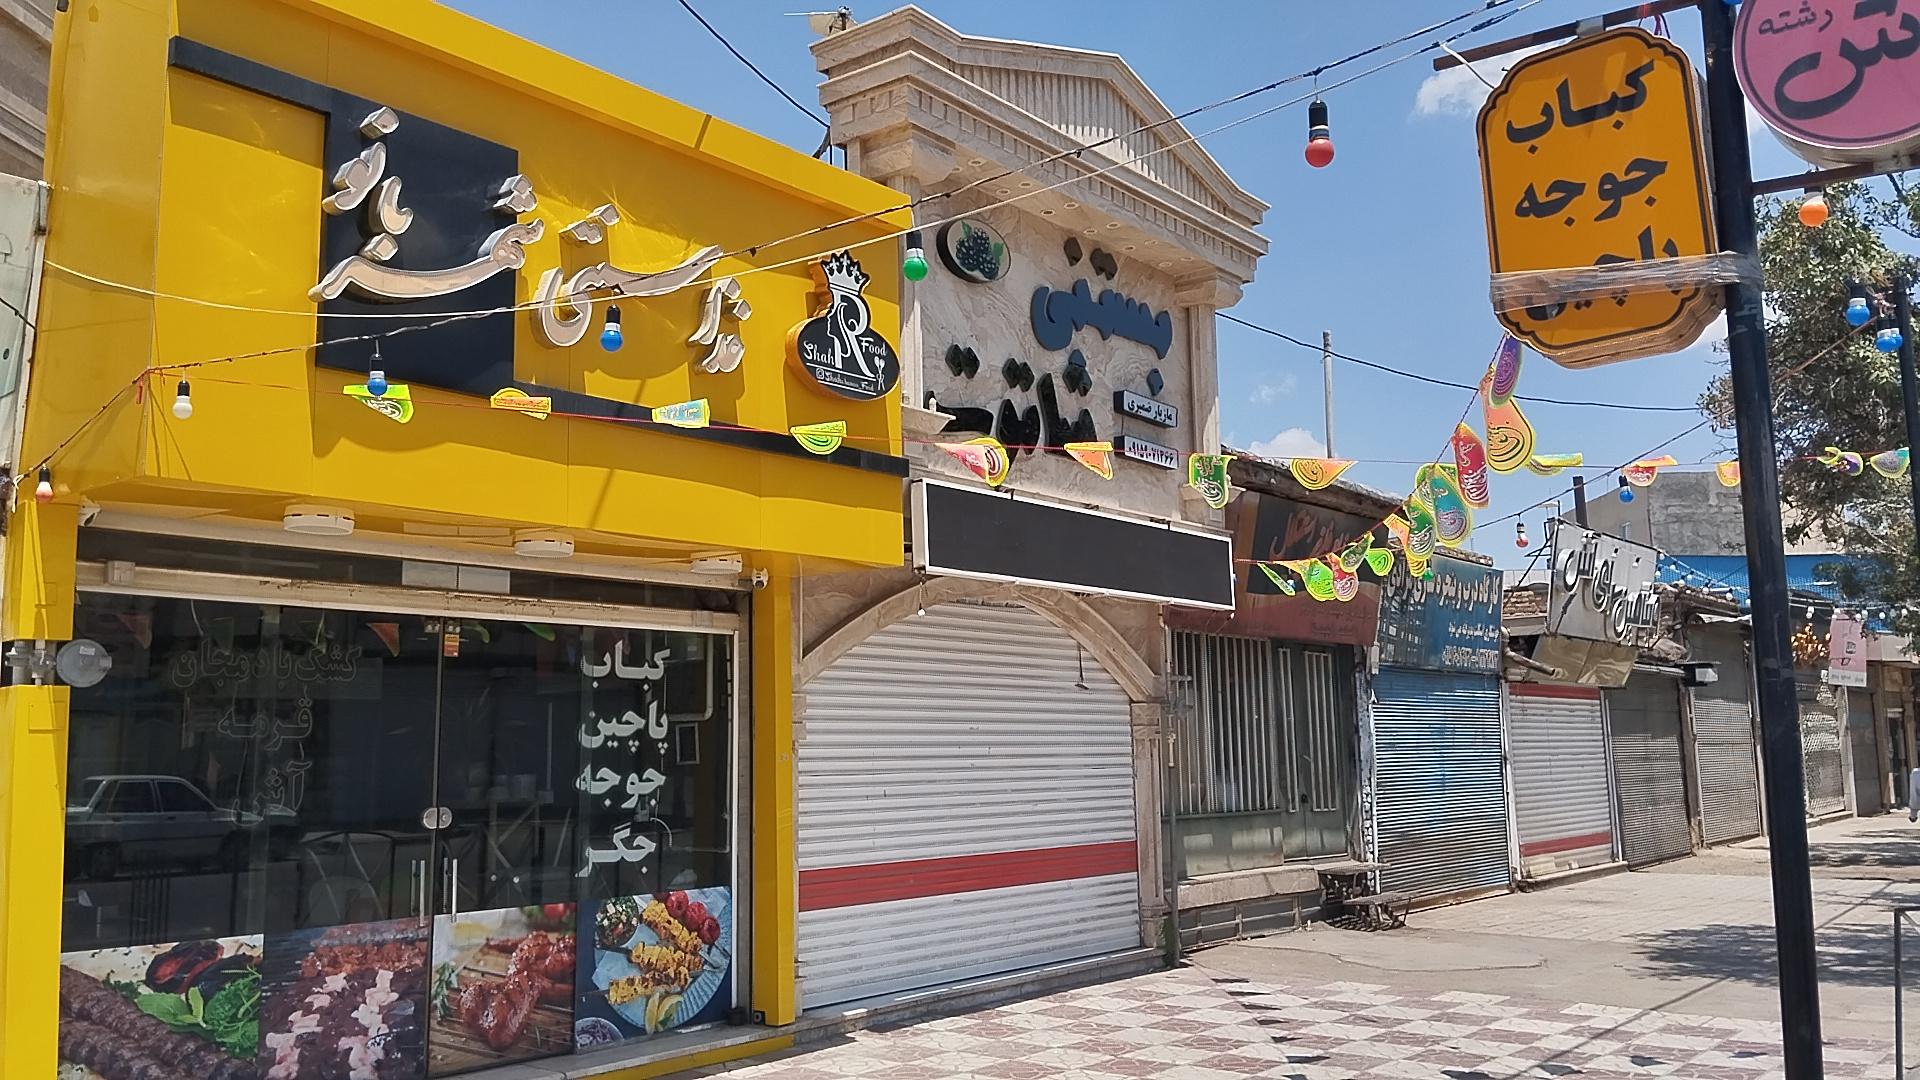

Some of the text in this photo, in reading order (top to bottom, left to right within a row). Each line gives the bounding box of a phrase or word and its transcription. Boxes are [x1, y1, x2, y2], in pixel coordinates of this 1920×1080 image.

[1758, 1, 1834, 35] رشته
[1506, 58, 1655, 154] کباب
[1514, 157, 1669, 227] جوجه
[1030, 236, 1174, 397] بستنی
[803, 340, 835, 365] Shah
[859, 336, 887, 356] Food
[172, 637, 362, 688] کشک بادمجان
[580, 640, 671, 690] کباب
[578, 700, 669, 754] پاچین
[575, 764, 667, 808] جوجه
[574, 821, 657, 878] جگر
